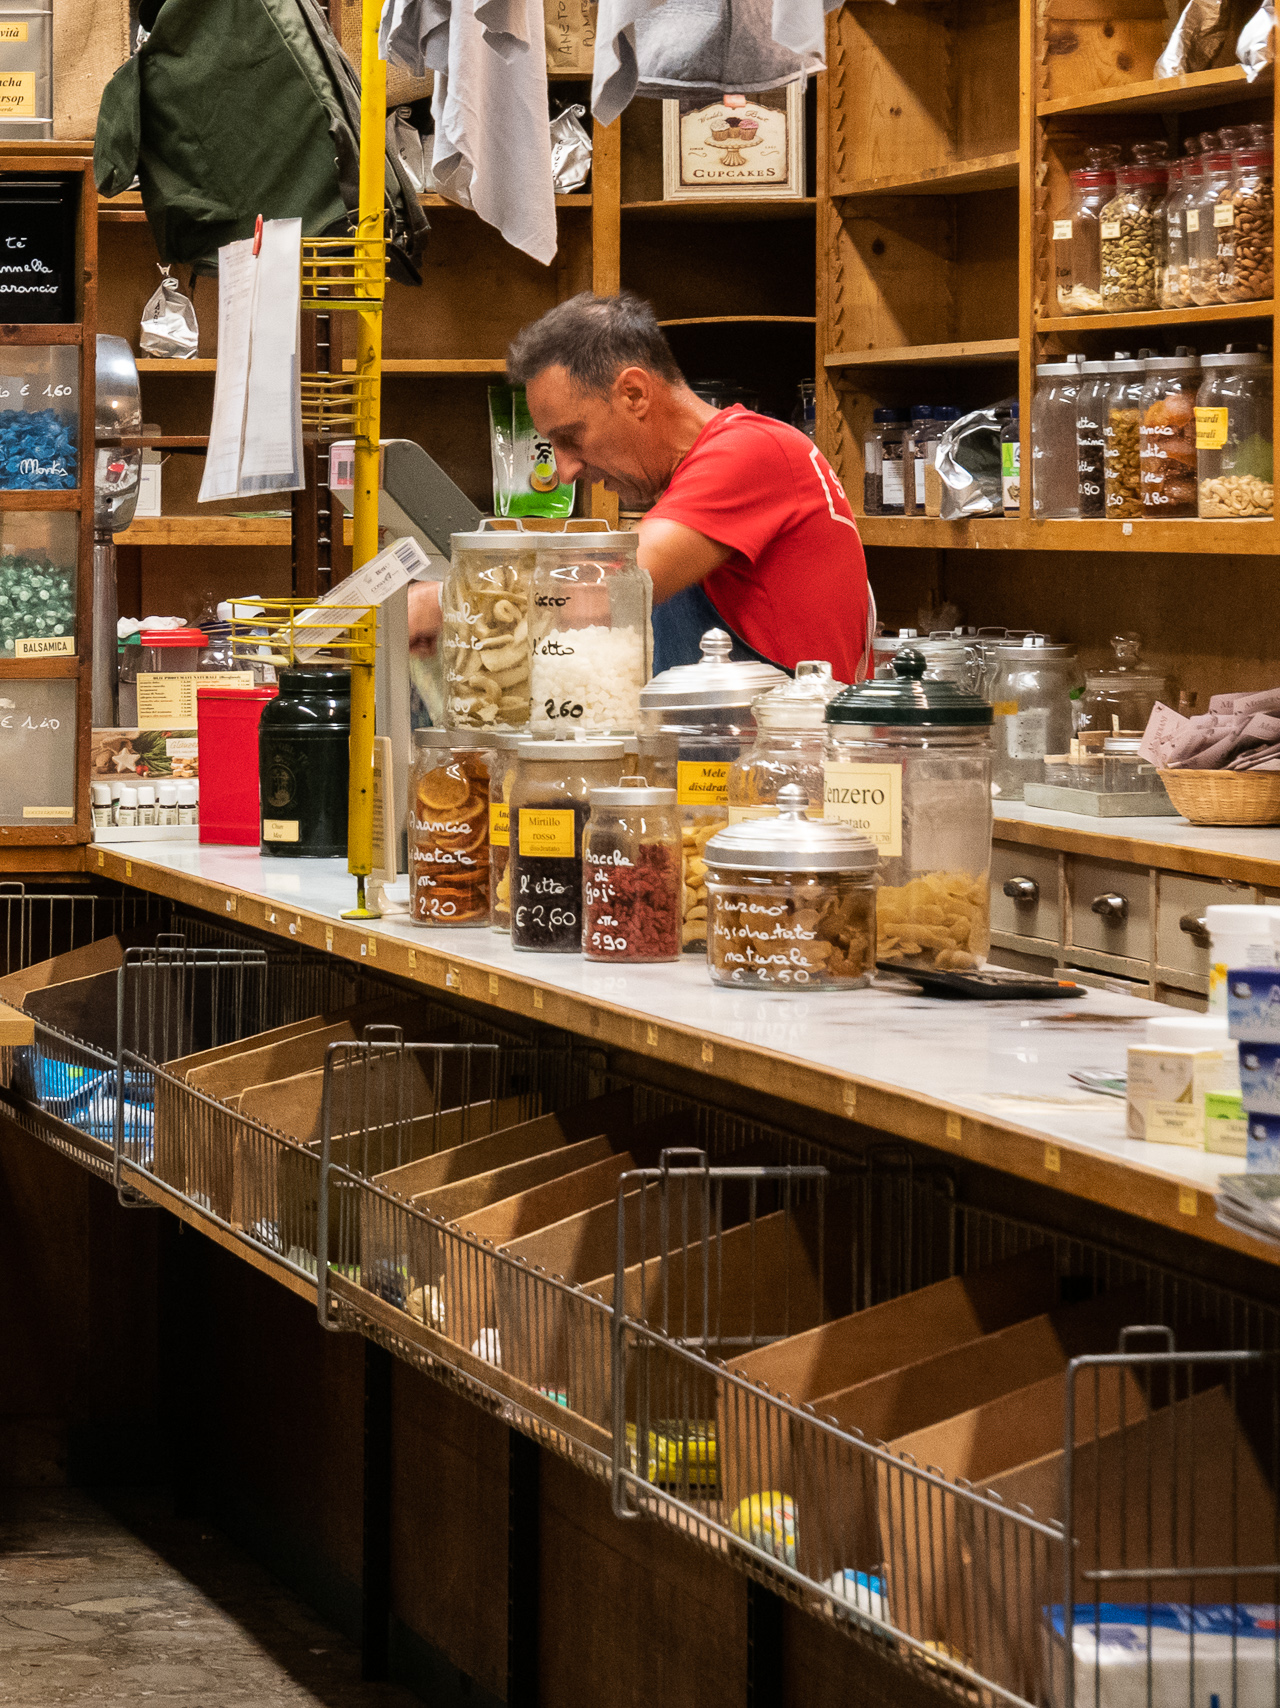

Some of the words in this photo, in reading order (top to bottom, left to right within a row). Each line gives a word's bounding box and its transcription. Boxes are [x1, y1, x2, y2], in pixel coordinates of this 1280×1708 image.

[557, 1, 572, 55] ANETO
[0, 283, 59, 294] arancio
[22, 641, 68, 653] BALSAMICA
[700, 767, 727, 779] Mele
[528, 816, 561, 828] Mirtillo
[532, 832, 556, 841] rosso
